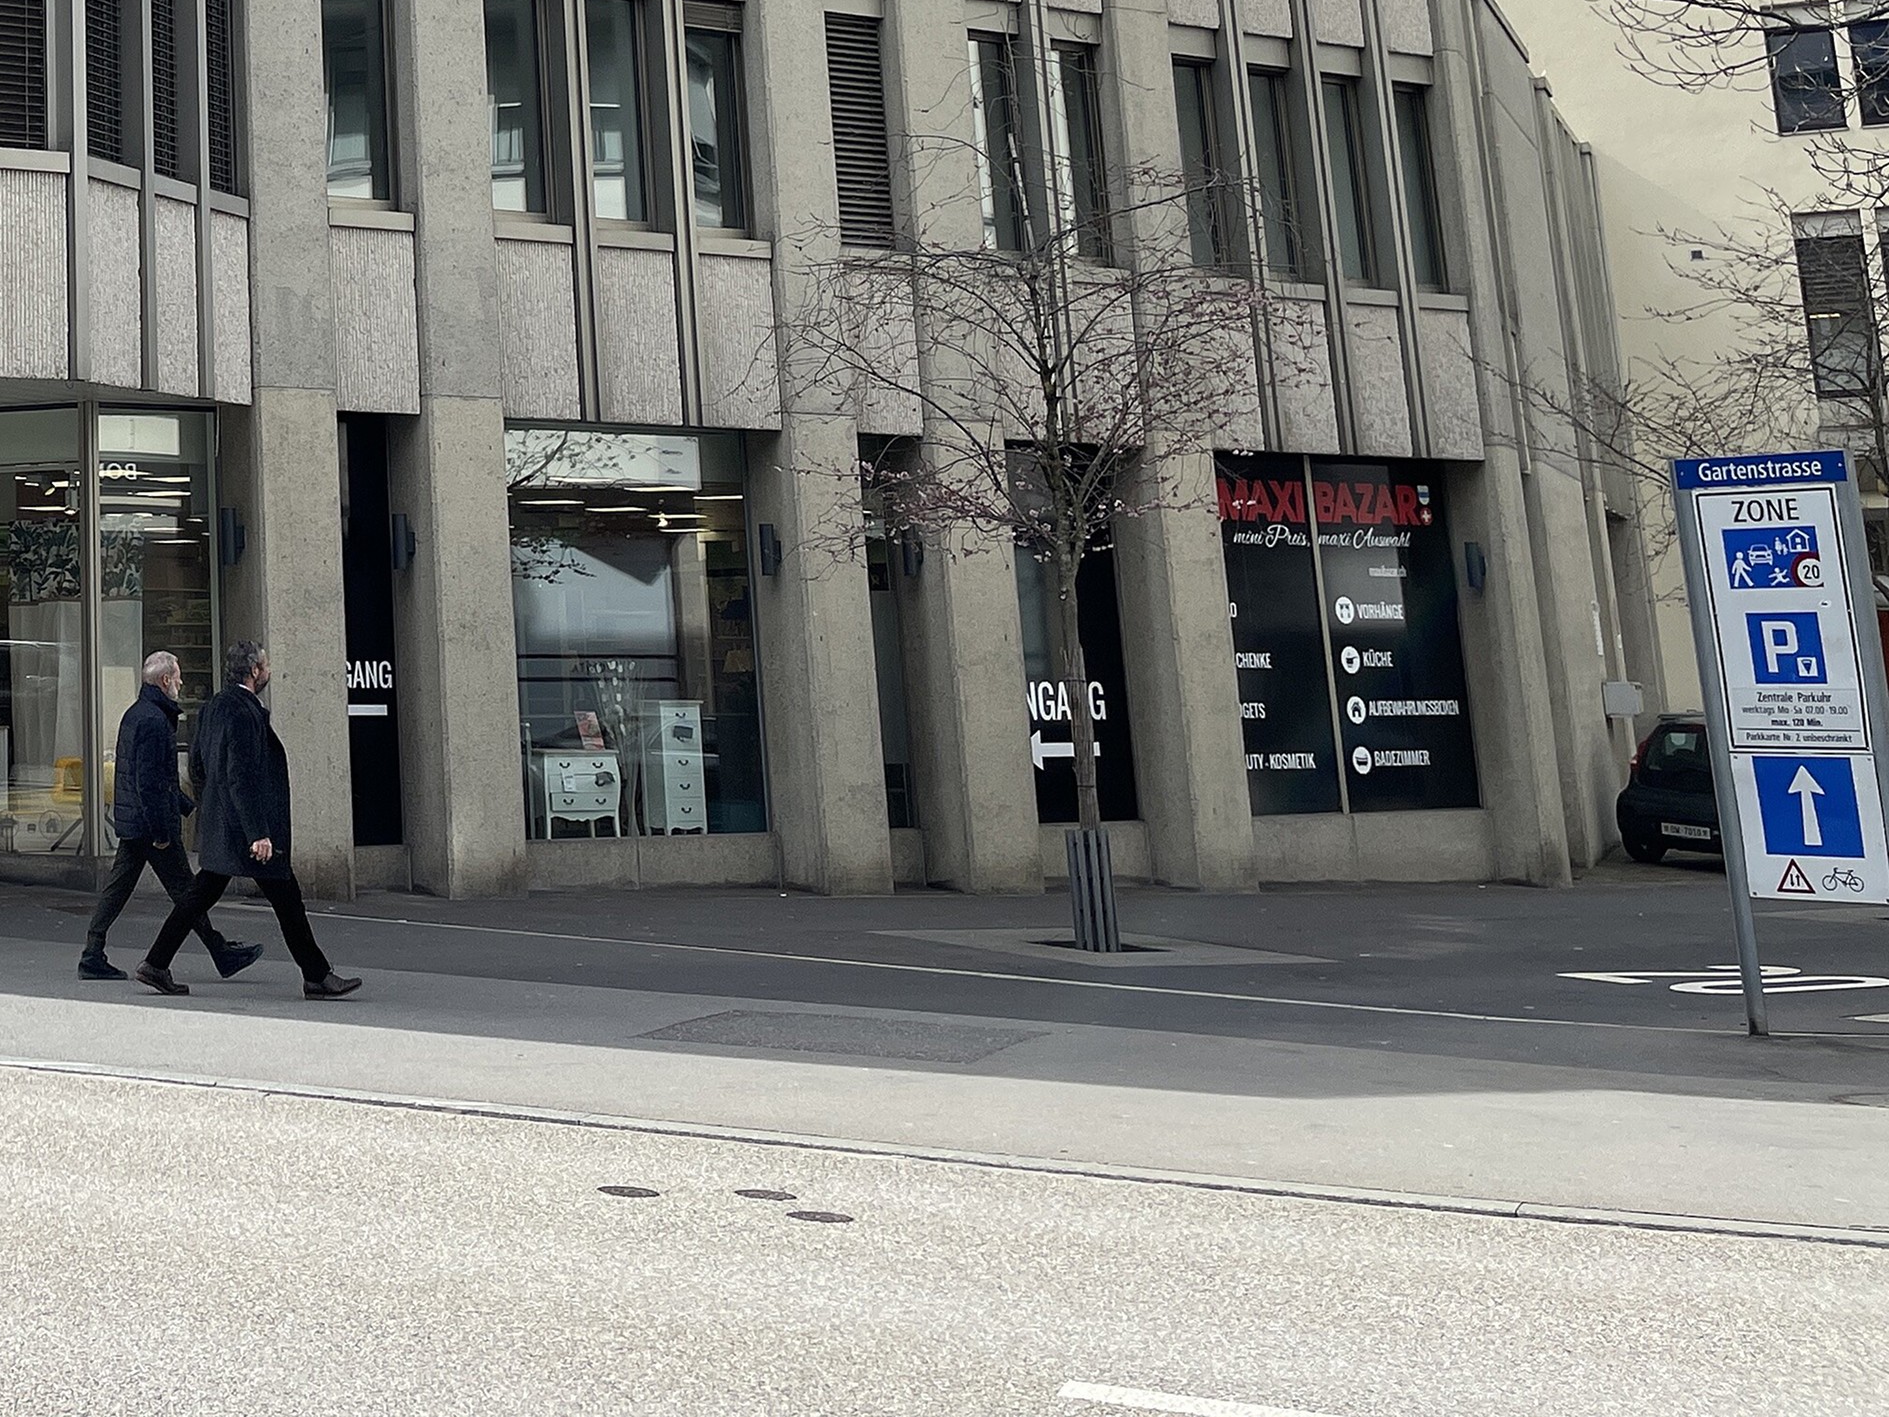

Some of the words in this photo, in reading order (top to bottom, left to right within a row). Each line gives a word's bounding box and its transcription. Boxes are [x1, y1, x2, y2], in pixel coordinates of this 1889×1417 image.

[1698, 460, 1822, 481] Gartenstrasse
[1216, 479, 1305, 523] MAXI
[1314, 482, 1422, 526] BAZAR
[1731, 498, 1800, 523] ZONE
[1233, 531, 1263, 545] mini
[1318, 532, 1352, 549] maxi
[1353, 527, 1411, 549] Auswahl
[1802, 564, 1820, 580] 20
[1356, 601, 1404, 620] VORHÄNGE
[1761, 620, 1799, 673] P
[1236, 653, 1272, 669] CHENKE
[1362, 649, 1393, 667] KÜCHE
[1026, 681, 1107, 721] NGAG
[1757, 691, 1793, 702] Zentrale
[1797, 691, 1832, 703] Parkuhr
[1742, 706, 1775, 716] werktags
[1746, 732, 1780, 741] Parkkarte
[1269, 753, 1316, 770] KOSMETIK
[1374, 750, 1430, 766] BADEZIMMER
